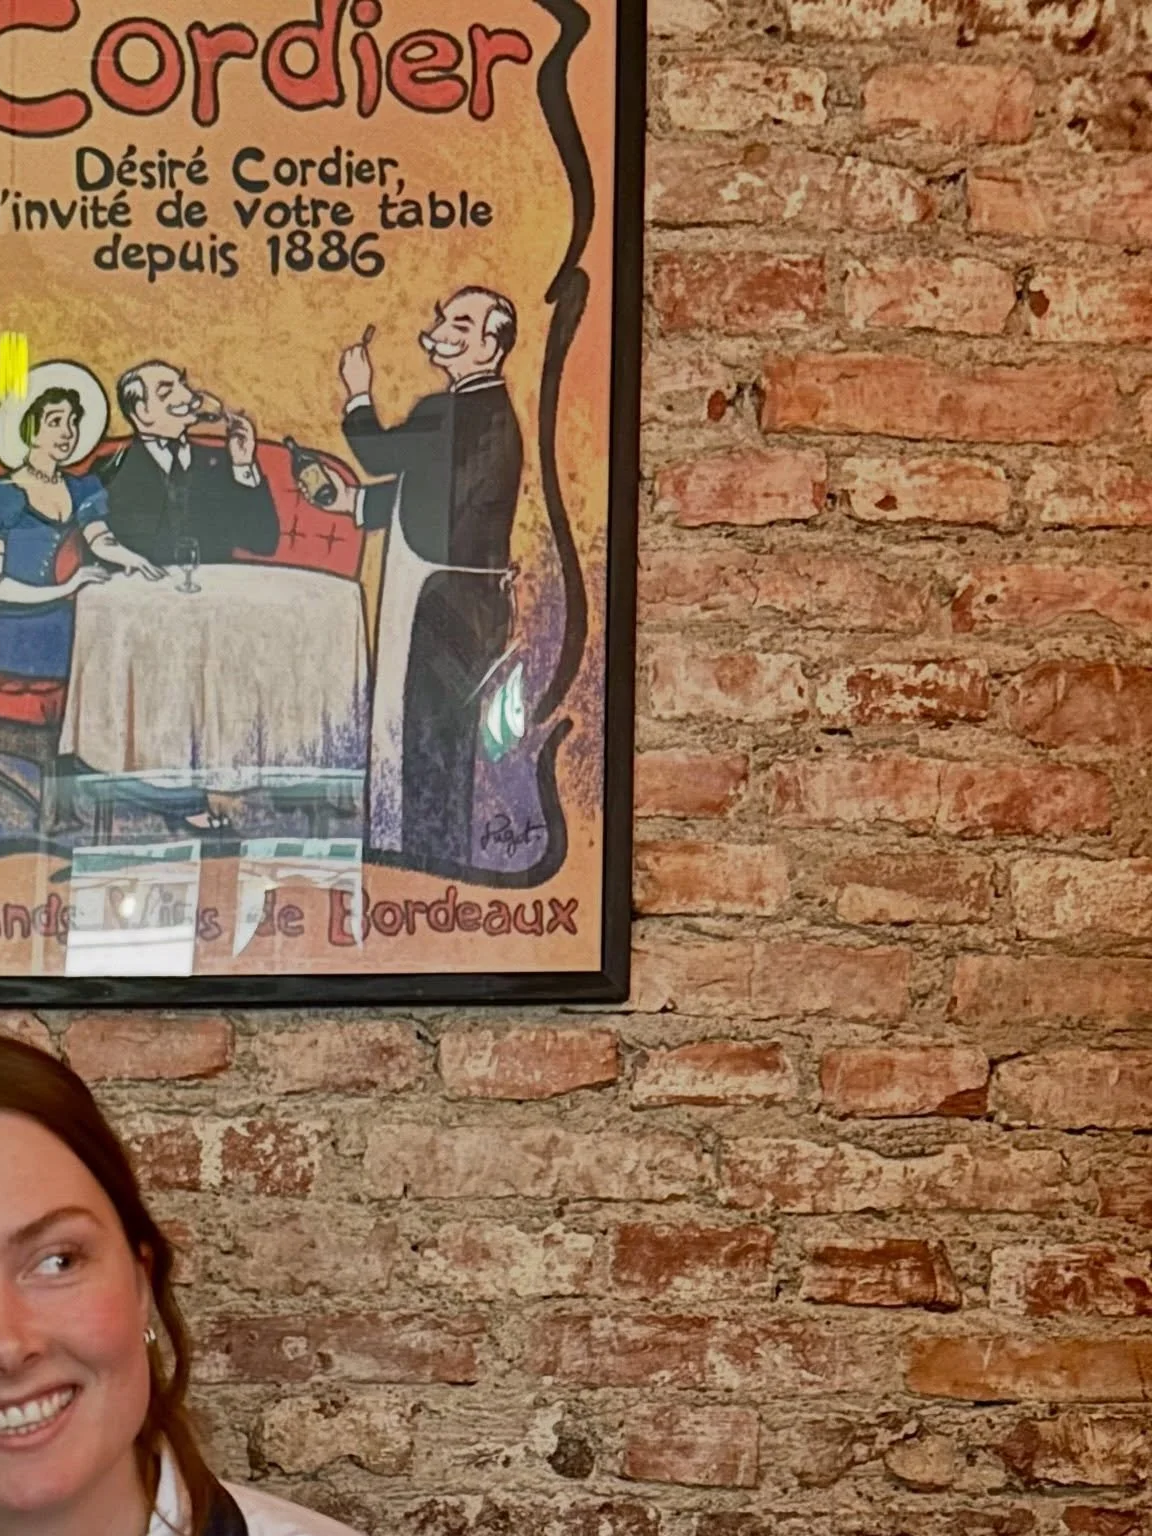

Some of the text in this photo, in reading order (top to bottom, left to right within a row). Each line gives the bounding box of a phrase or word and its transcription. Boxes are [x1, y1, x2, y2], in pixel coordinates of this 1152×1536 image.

[75, 145, 405, 196] Désiré Cordier,
[157, 192, 208, 229] de
[236, 192, 353, 229] votre
[378, 192, 493, 229] table
[93, 232, 385, 282] depuis 1886
[328, 885, 579, 947] Bordeaux
